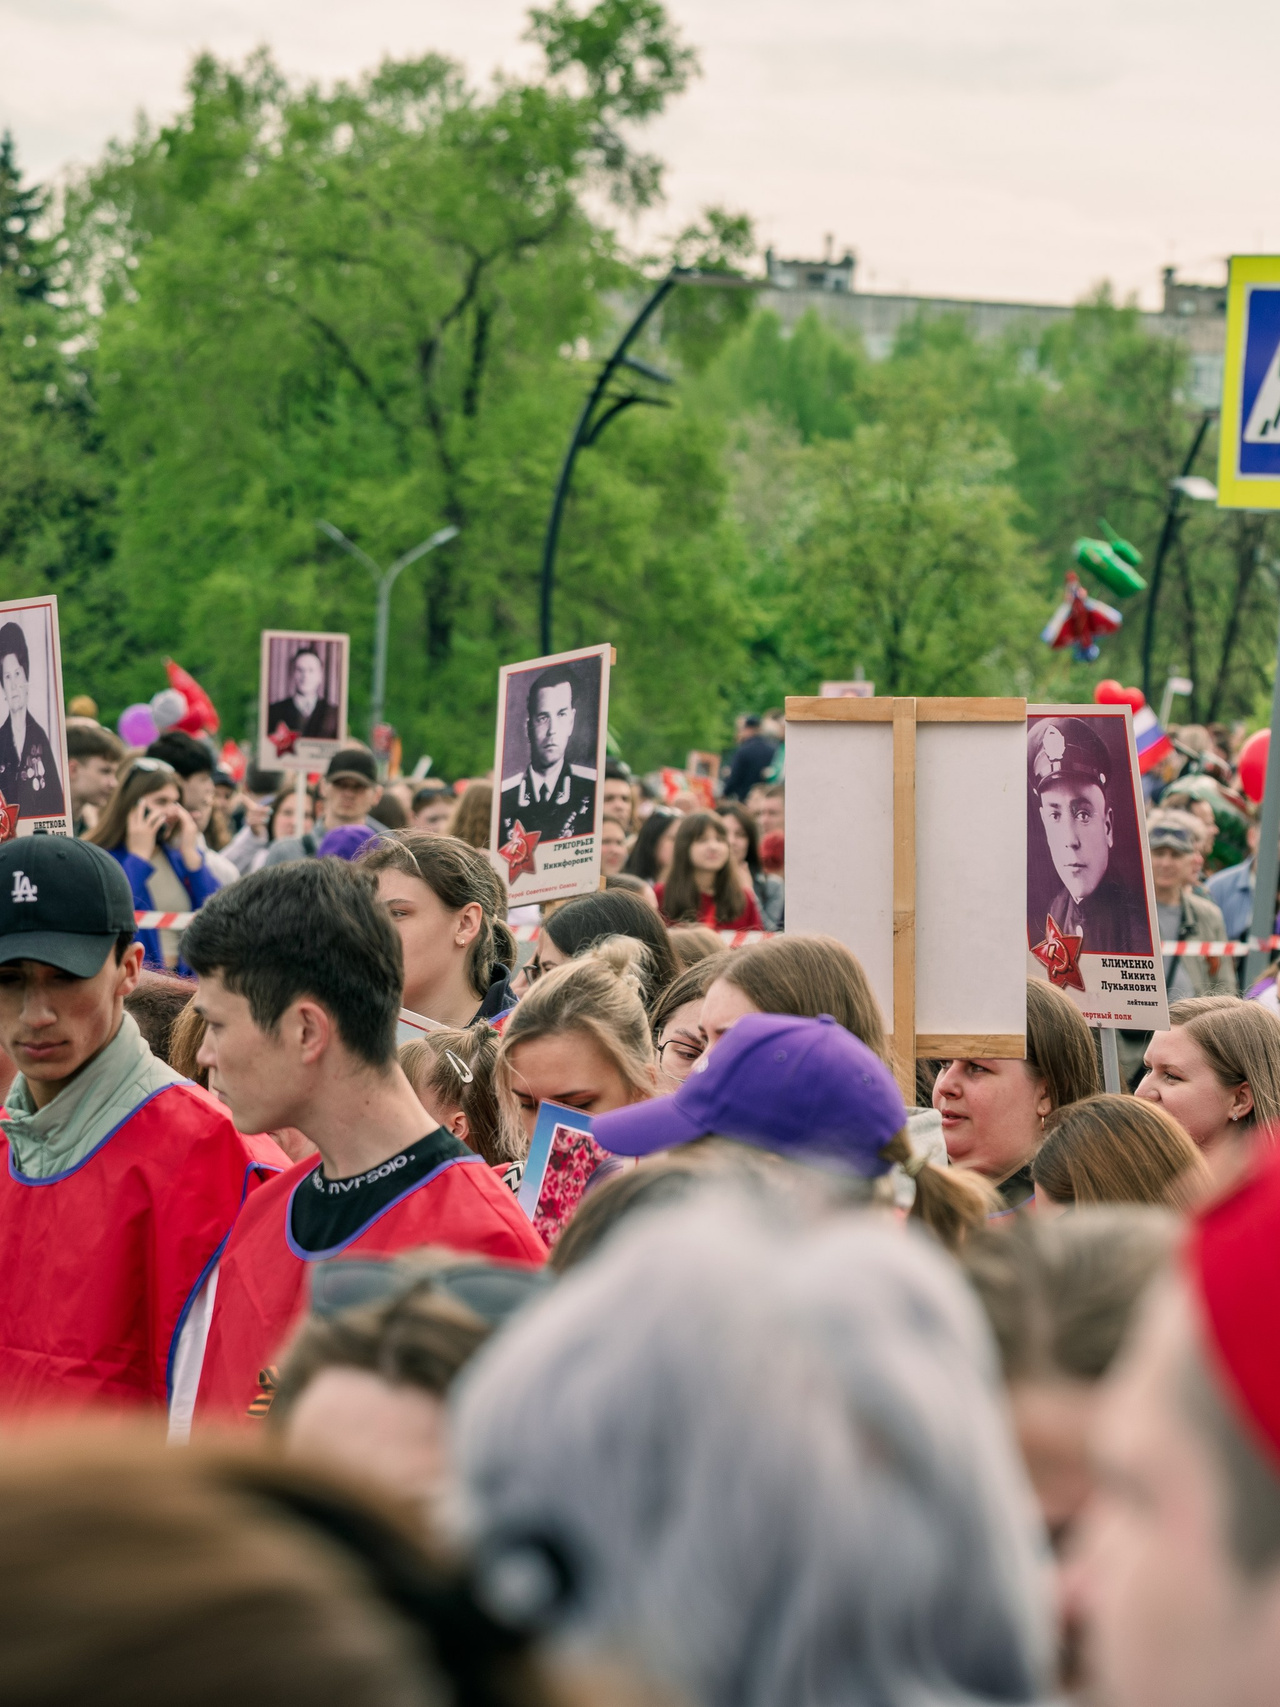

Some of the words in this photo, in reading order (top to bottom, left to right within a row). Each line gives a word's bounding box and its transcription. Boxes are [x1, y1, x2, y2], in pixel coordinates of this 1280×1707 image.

[553, 838, 594, 851] ГРИГОРЬЕВ
[574, 847, 594, 856] Фома
[543, 856, 593, 870] Никифорович
[11, 870, 38, 903] LA
[1101, 958, 1154, 970] КЛИМЕНКО
[1120, 970, 1156, 981] Никита
[1101, 981, 1157, 992] Лукьянович
[1126, 999, 1159, 1007] лейтенант
